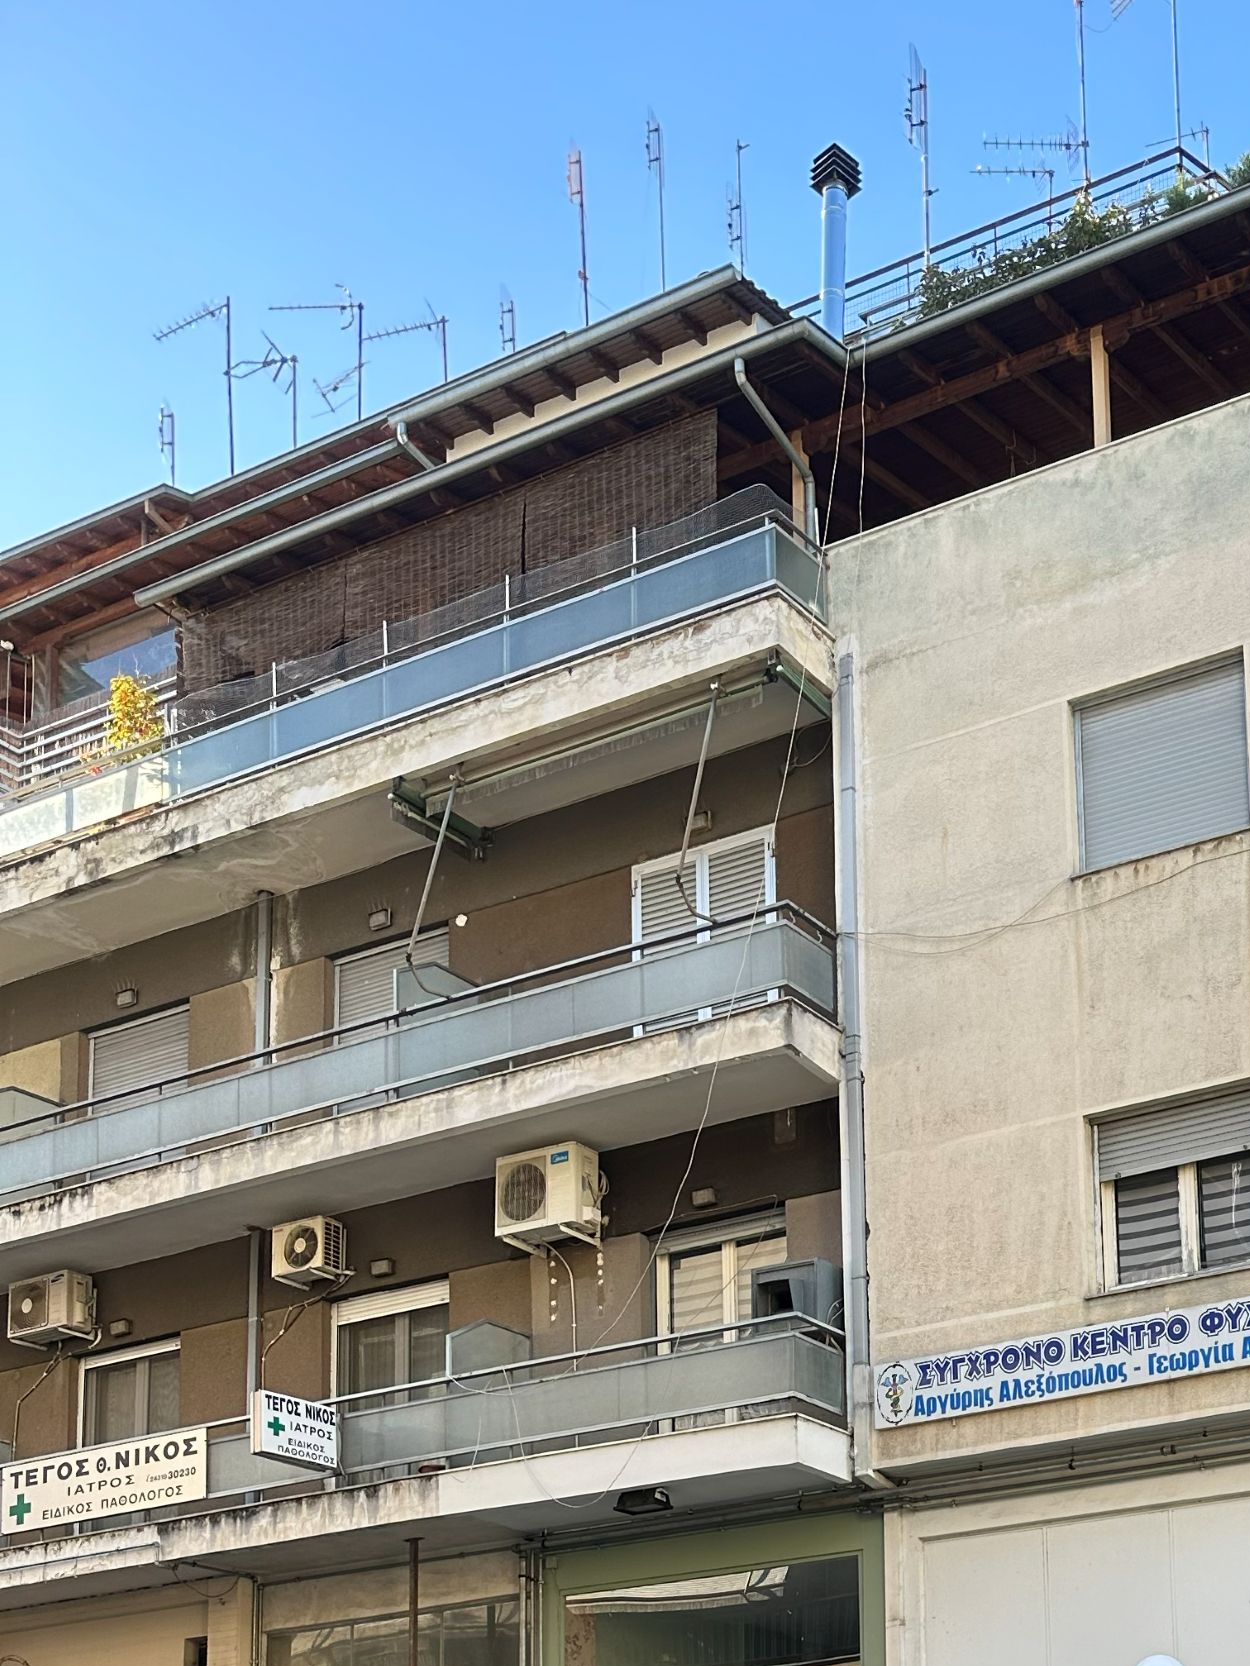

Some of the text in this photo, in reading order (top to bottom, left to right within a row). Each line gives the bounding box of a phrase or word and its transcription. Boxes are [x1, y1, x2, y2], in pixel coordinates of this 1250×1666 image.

[915, 1338, 1066, 1390] ΣΥΓΧΡΟΝΟ
[1071, 1314, 1190, 1362] ΚΕΝΤΡΟ
[914, 1386, 994, 1417] Αργύρης
[999, 1361, 1127, 1402] Αλεξόπουλος
[1148, 1341, 1235, 1377] Γεωργία
[265, 1394, 336, 1426] ΤΕΓΟΣ ΝΙΚΟΣ
[288, 1438, 325, 1453] ΕΙΔΙΚΟΣ
[290, 1421, 333, 1440] ΙΑΤΡΟΣ
[10, 1458, 90, 1489] ΤΕΓΟΣ
[115, 1437, 198, 1470] ΝΙΚΟΣ
[278, 1445, 335, 1465] ΠΑΘΟΛΟΓΟΣ
[67, 1475, 135, 1496] ΙΑΤΡΟΣ
[42, 1485, 183, 1520] ΕΙΔΙΚΟΣ ΠΑΘΟΛΟΓΟΣ
